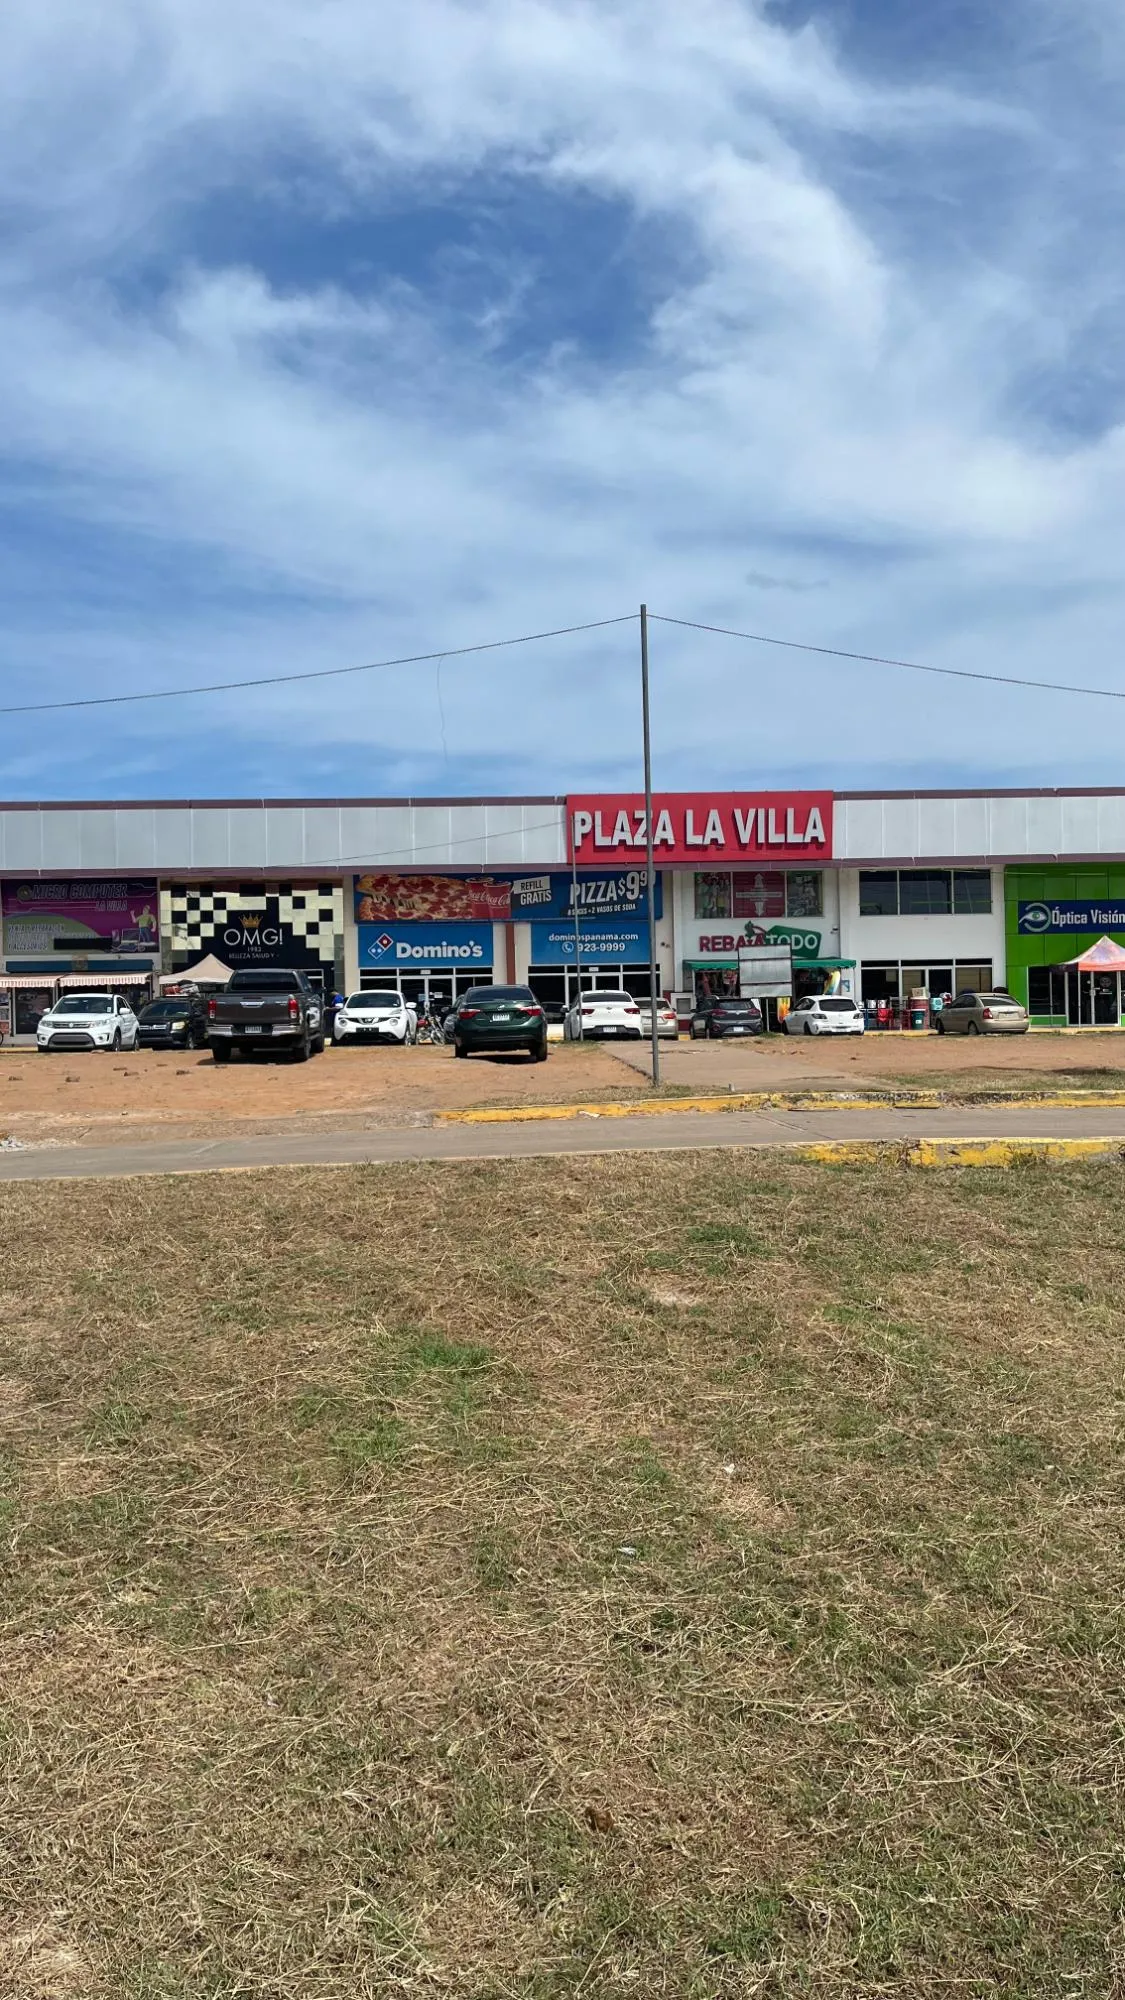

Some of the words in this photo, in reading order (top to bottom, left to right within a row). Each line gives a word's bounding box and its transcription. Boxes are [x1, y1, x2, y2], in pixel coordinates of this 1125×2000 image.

[574, 809, 675, 847] PLAZA
[685, 808, 725, 846] LA
[734, 807, 826, 844] VILLA
[32, 884, 69, 900] MICRO
[69, 883, 128, 898] COMPUTER
[520, 880, 543, 891] REFILL
[569, 880, 617, 905] PIZZA
[520, 890, 552, 906] GRATIS
[597, 905, 613, 914] VASOS
[614, 904, 621, 912] DE
[622, 903, 636, 911] SODA
[1051, 906, 1088, 927] Óptica
[1090, 909, 1125, 924] Visión
[223, 928, 283, 946] OMG!
[577, 942, 626, 952] 923-9999
